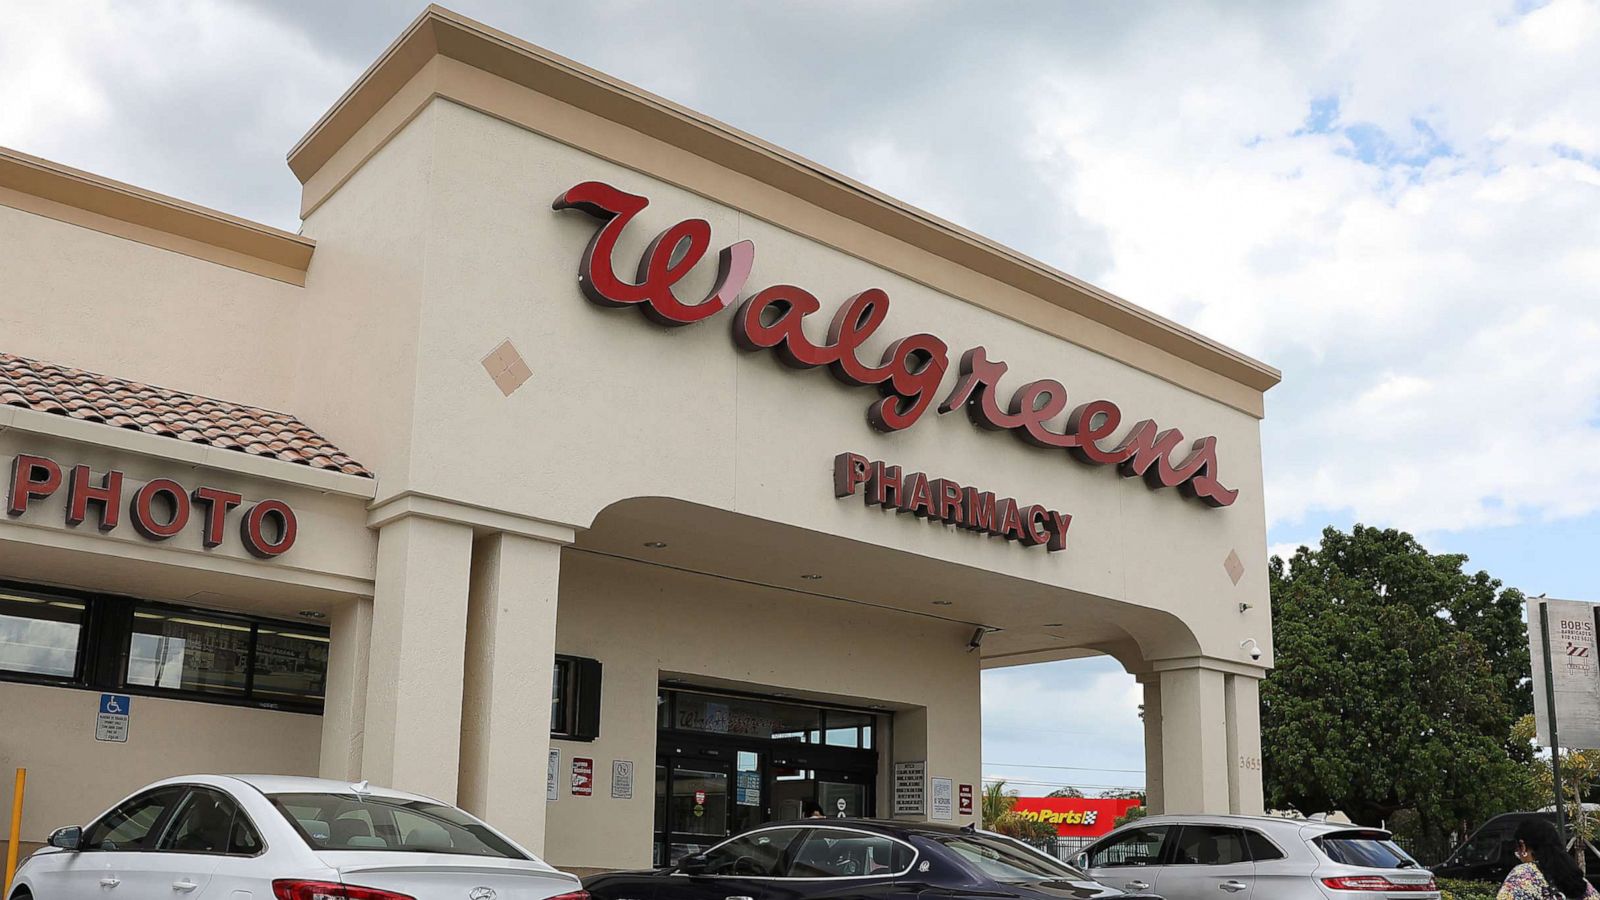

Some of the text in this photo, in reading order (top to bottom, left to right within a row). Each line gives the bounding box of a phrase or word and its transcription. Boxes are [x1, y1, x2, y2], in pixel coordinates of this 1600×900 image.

[552, 180, 1239, 507] Walgreens
[7, 454, 298, 558] PHOTO
[834, 452, 1072, 552] PHARMACY
[1561, 620, 1591, 631] BOB'S
[1038, 809, 1082, 824] Parts
